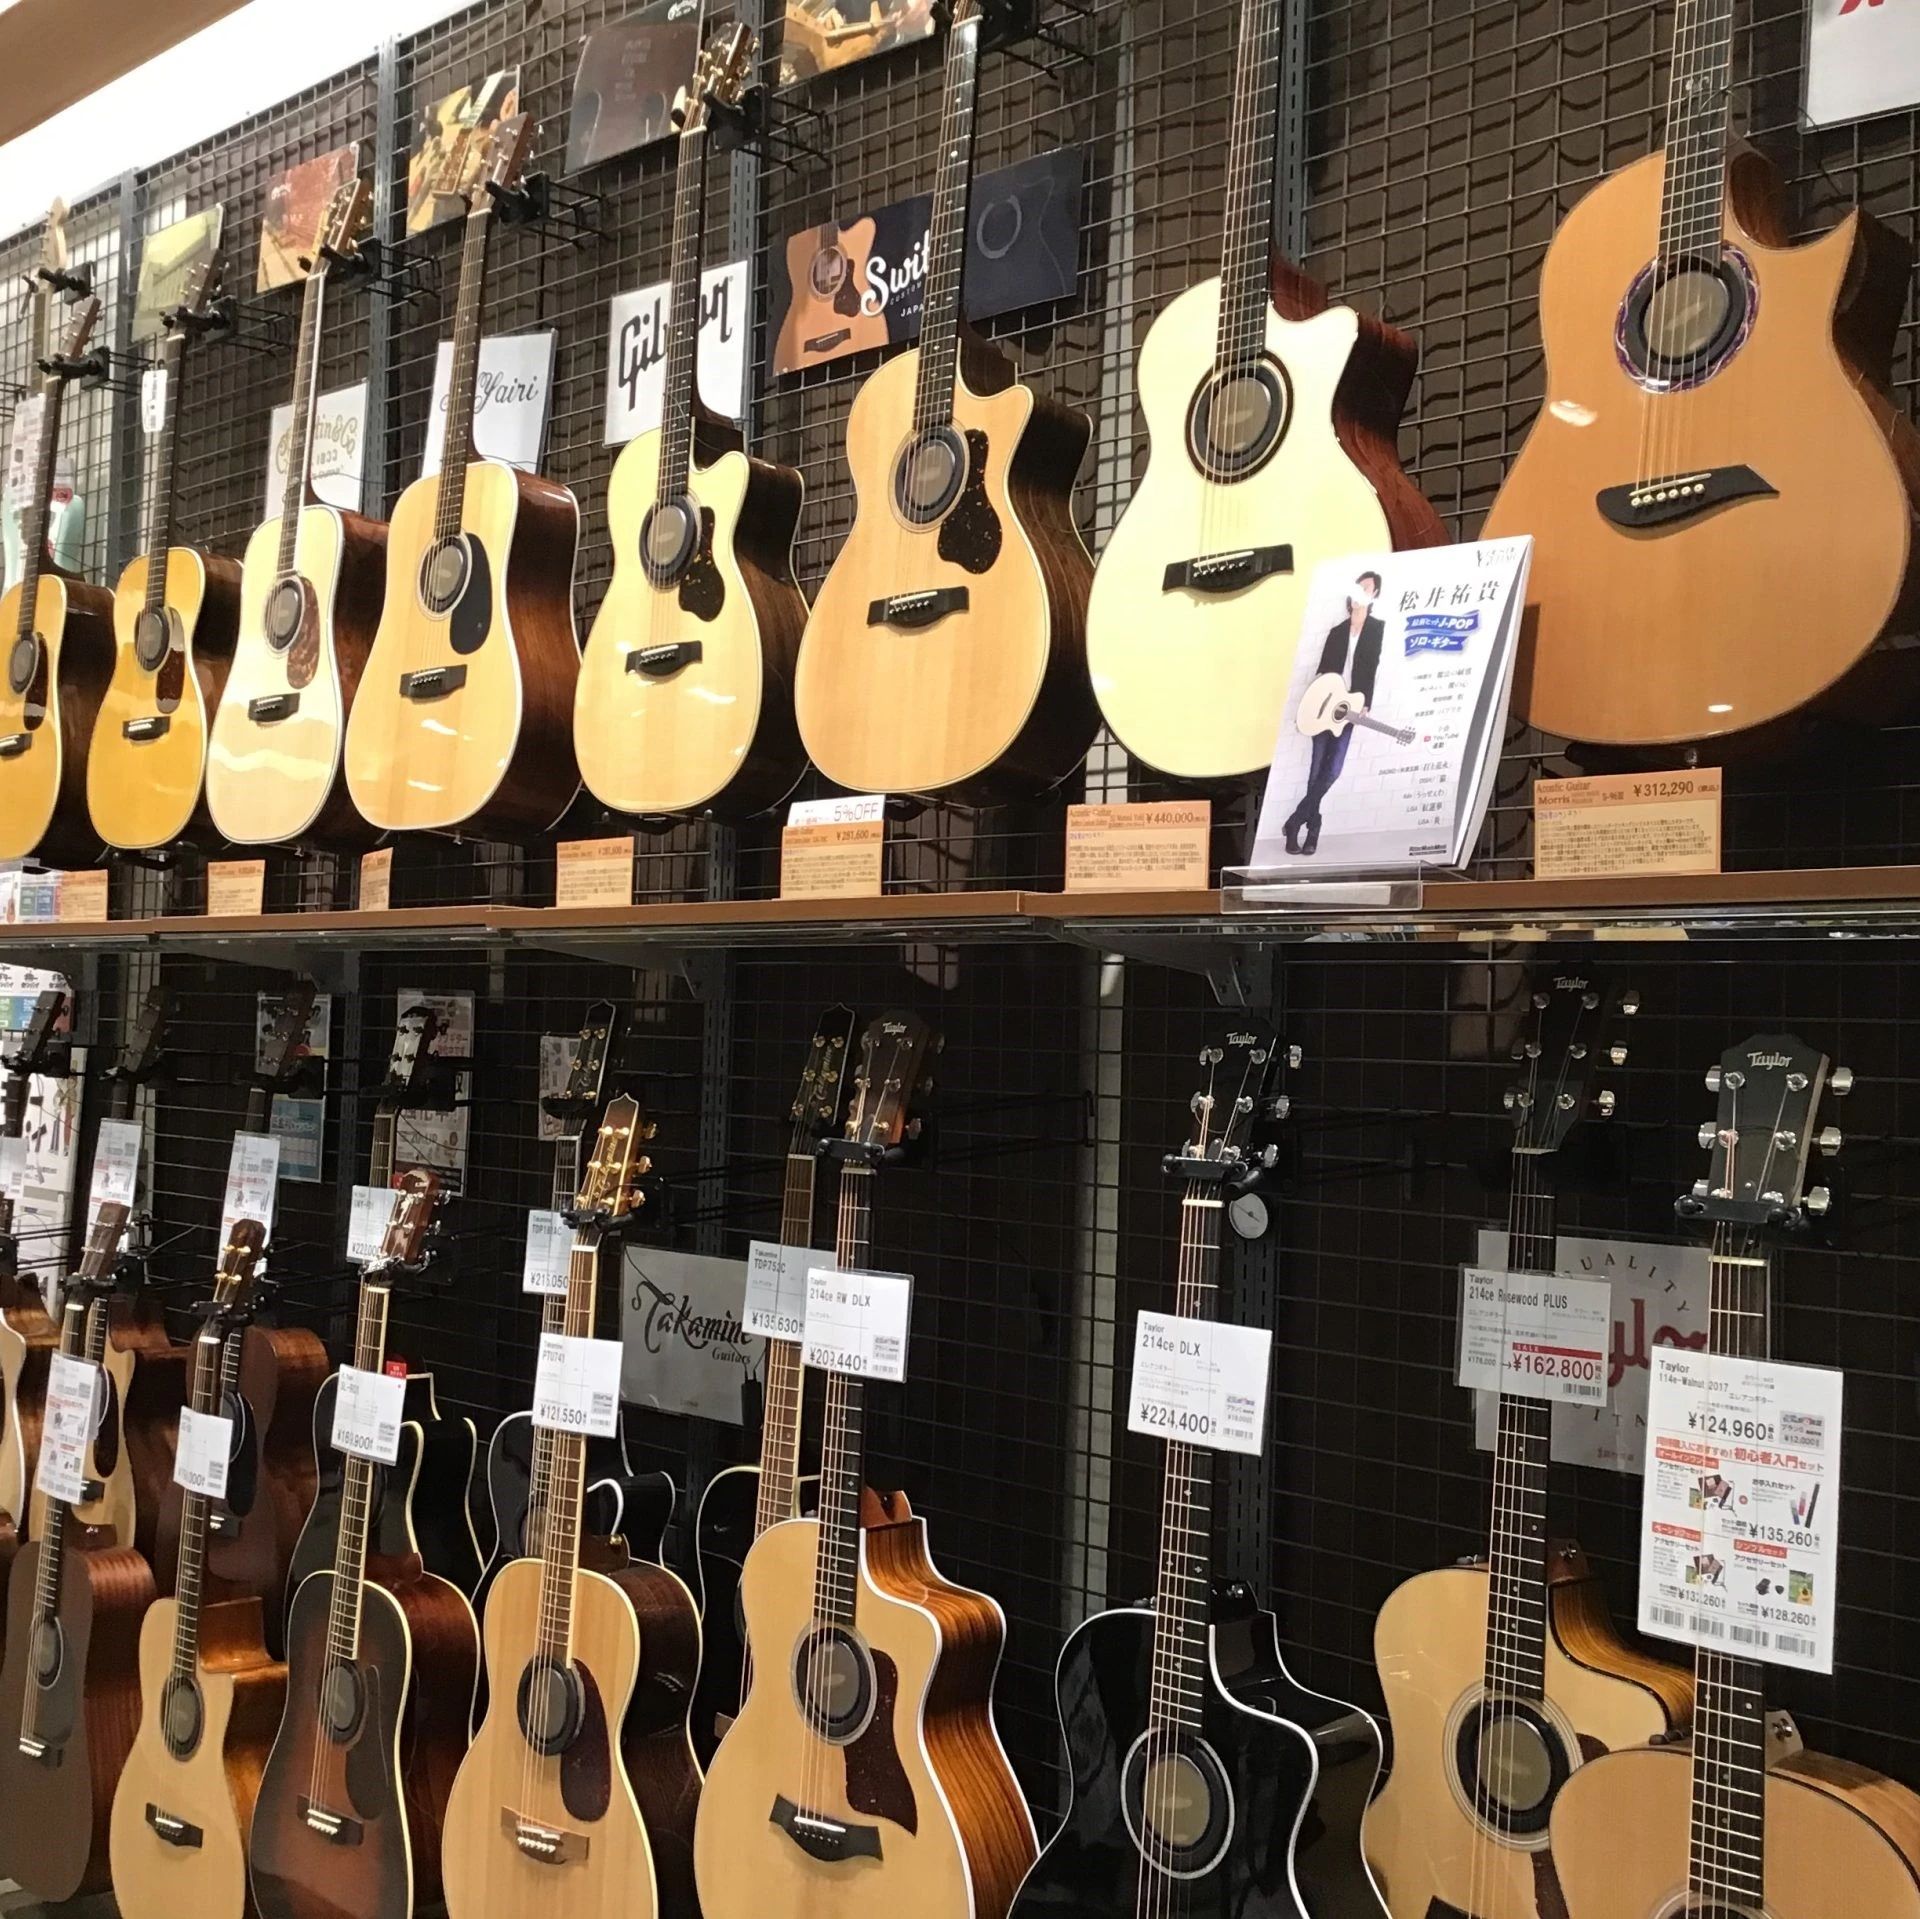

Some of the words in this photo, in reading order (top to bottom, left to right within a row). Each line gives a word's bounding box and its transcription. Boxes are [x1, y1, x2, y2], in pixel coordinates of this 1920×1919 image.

[901, 303, 924, 317] JAPA
[1633, 780, 1694, 798] ¥312,290
[833, 802, 879, 822] 5%OFF
[1146, 811, 1194, 824] ¥440,000
[1553, 976, 1589, 992] Taylor
[883, 1022, 907, 1035] Taylor
[1226, 1032, 1258, 1047] Taylor
[1747, 1051, 1793, 1070] Taylor
[1469, 1274, 1494, 1285] Taylor
[809, 1288, 833, 1302] 214ce
[852, 1294, 871, 1307] DLX
[1469, 1286, 1495, 1302] 214ce
[1543, 1294, 1568, 1309] PLUS
[1142, 1334, 1175, 1352] 214ce
[1180, 1340, 1201, 1356] DLX
[1513, 1353, 1594, 1382] ¥162,800
[1659, 1360, 1690, 1374] Taylor
[1707, 1381, 1729, 1392] 2017
[1140, 1402, 1209, 1435] ¥224,400
[1688, 1411, 1767, 1441] ¥124,960
[1749, 1524, 1812, 1548] ¥135,260
[1761, 1606, 1810, 1626] ¥128,260
